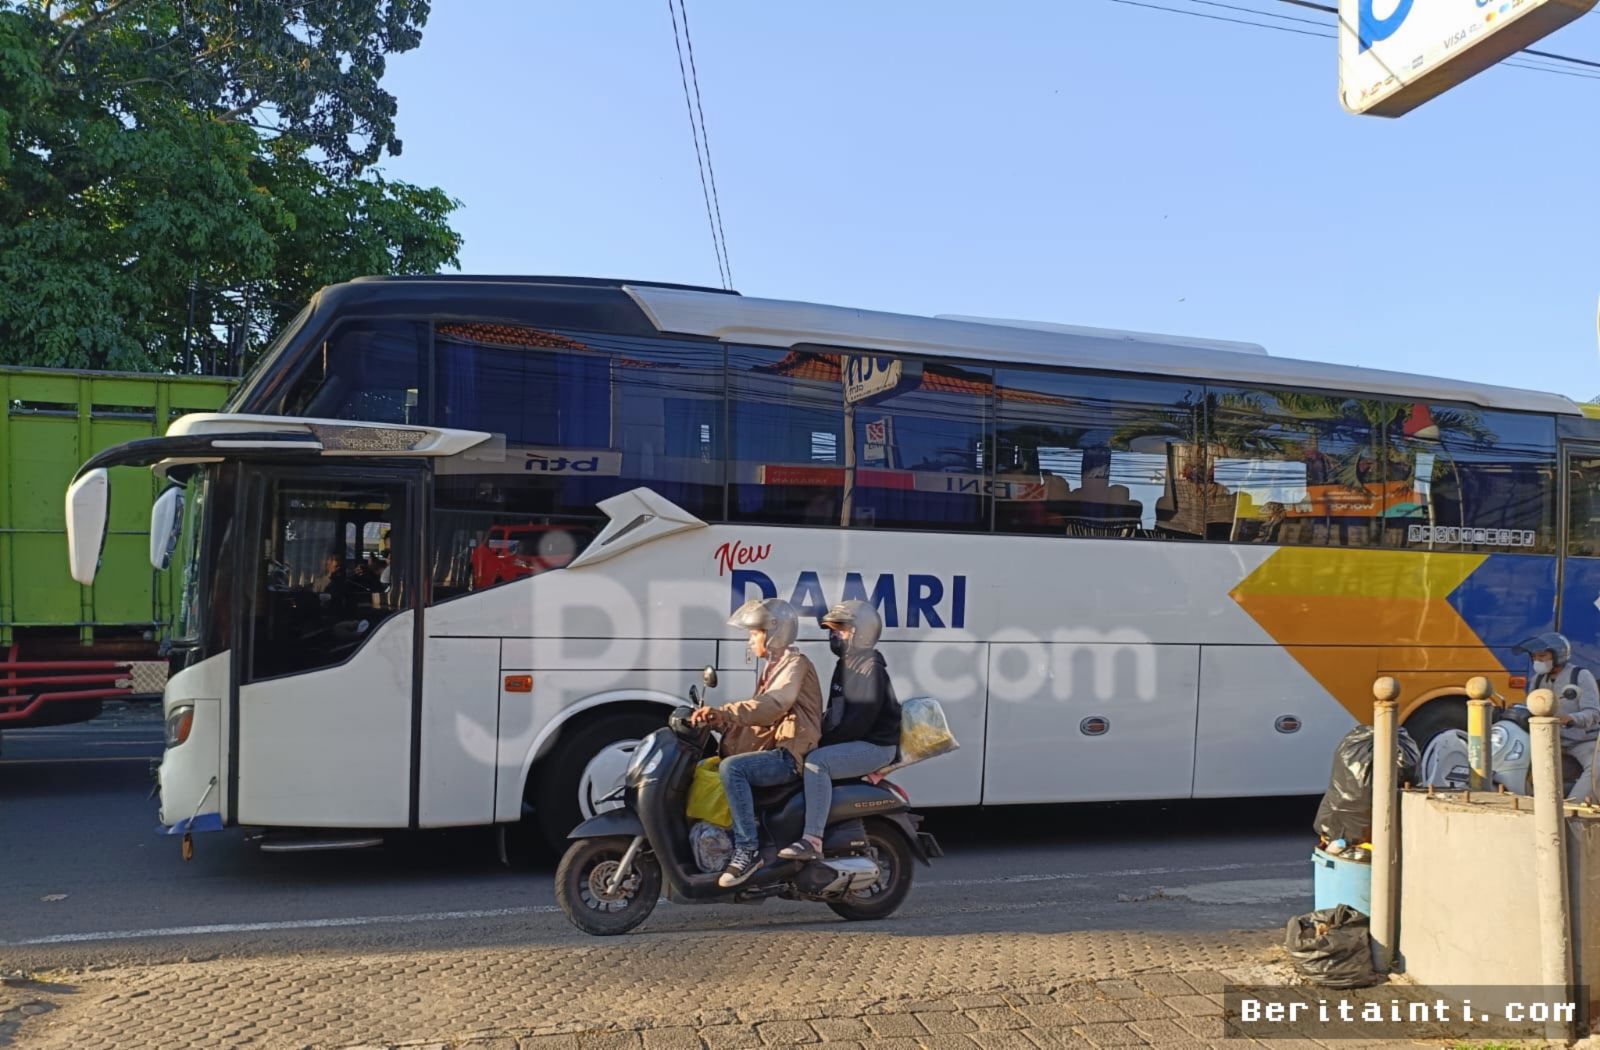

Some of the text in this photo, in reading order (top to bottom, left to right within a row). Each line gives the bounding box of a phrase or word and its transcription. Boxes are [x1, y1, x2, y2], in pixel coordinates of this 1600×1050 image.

[1443, 29, 1466, 48] VISA
[714, 540, 771, 576] New
[731, 569, 967, 629] DAMRI
